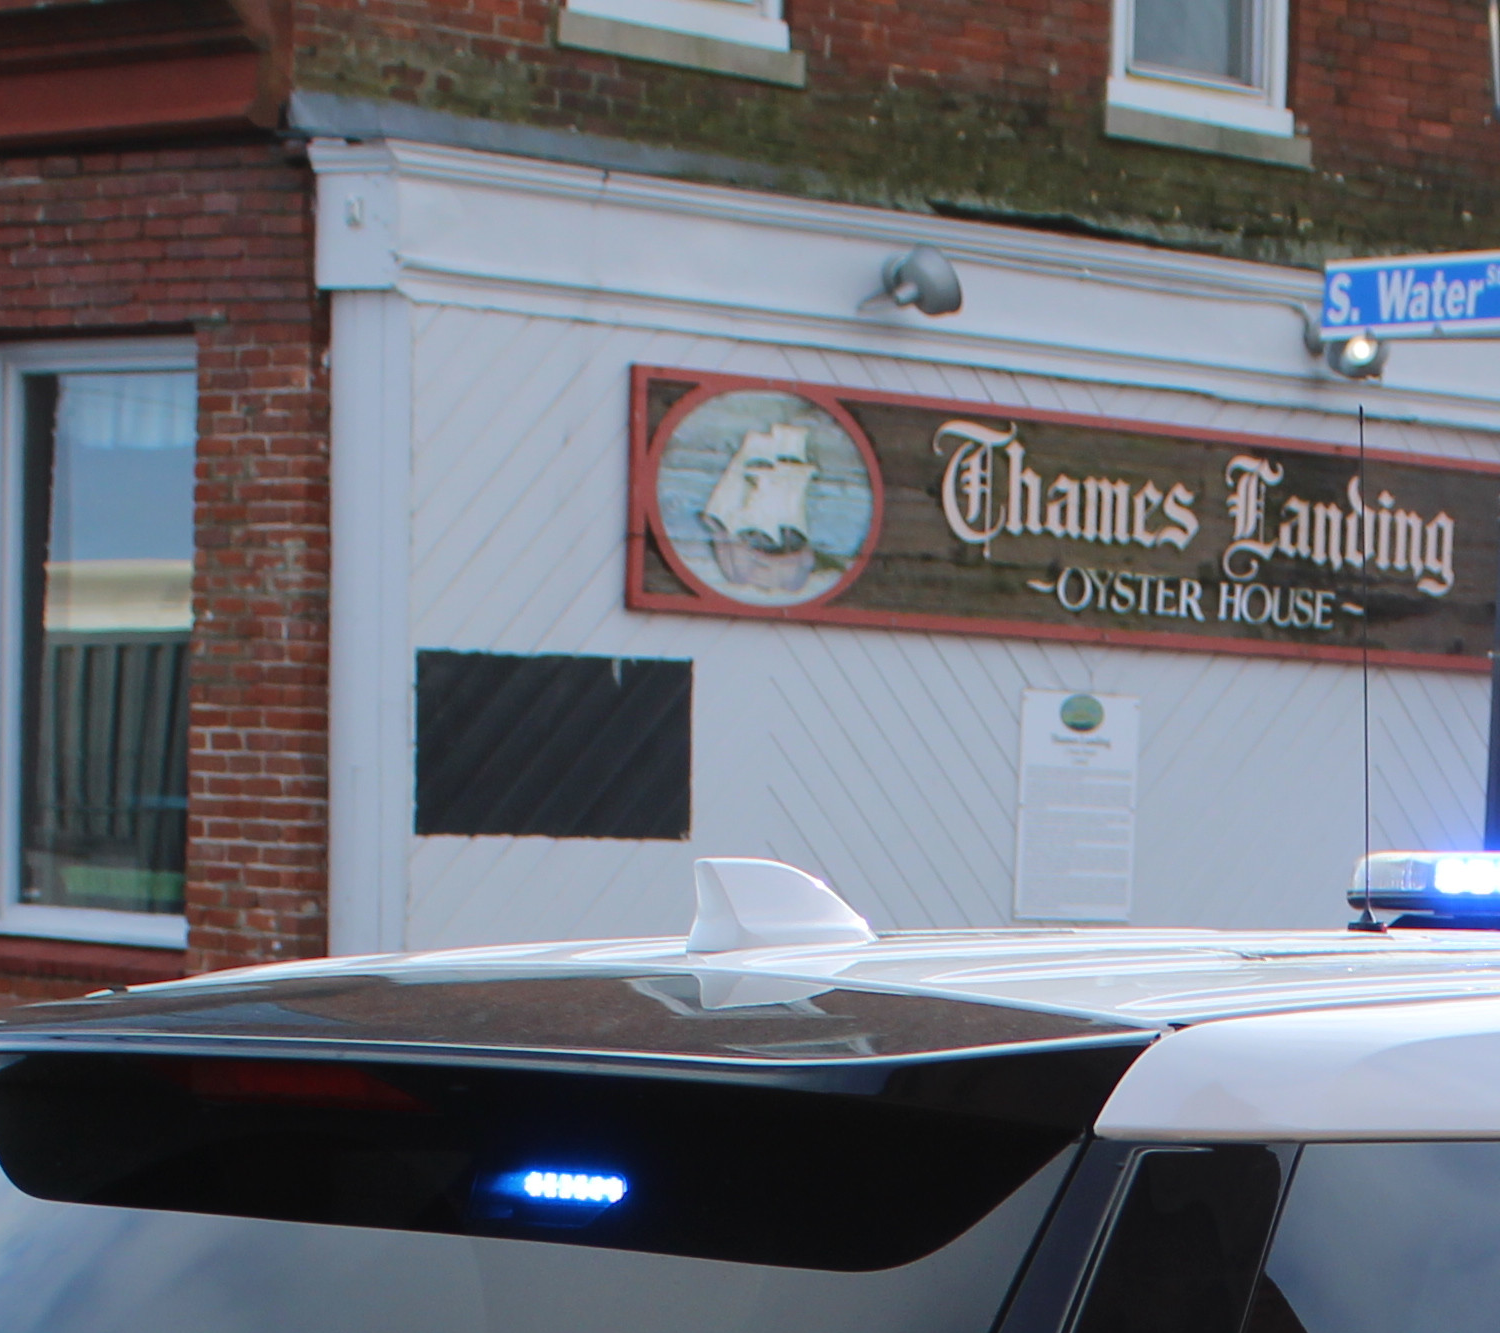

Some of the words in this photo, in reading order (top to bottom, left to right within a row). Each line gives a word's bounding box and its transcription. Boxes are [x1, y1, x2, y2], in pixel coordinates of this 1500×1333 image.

[1326, 273, 1359, 324] S.
[1377, 269, 1483, 321] Water
[932, 420, 1198, 558] Thames
[1222, 454, 1456, 597] Landing
[1056, 564, 1203, 623] OYSTER
[1217, 581, 1335, 632] HOUSE
